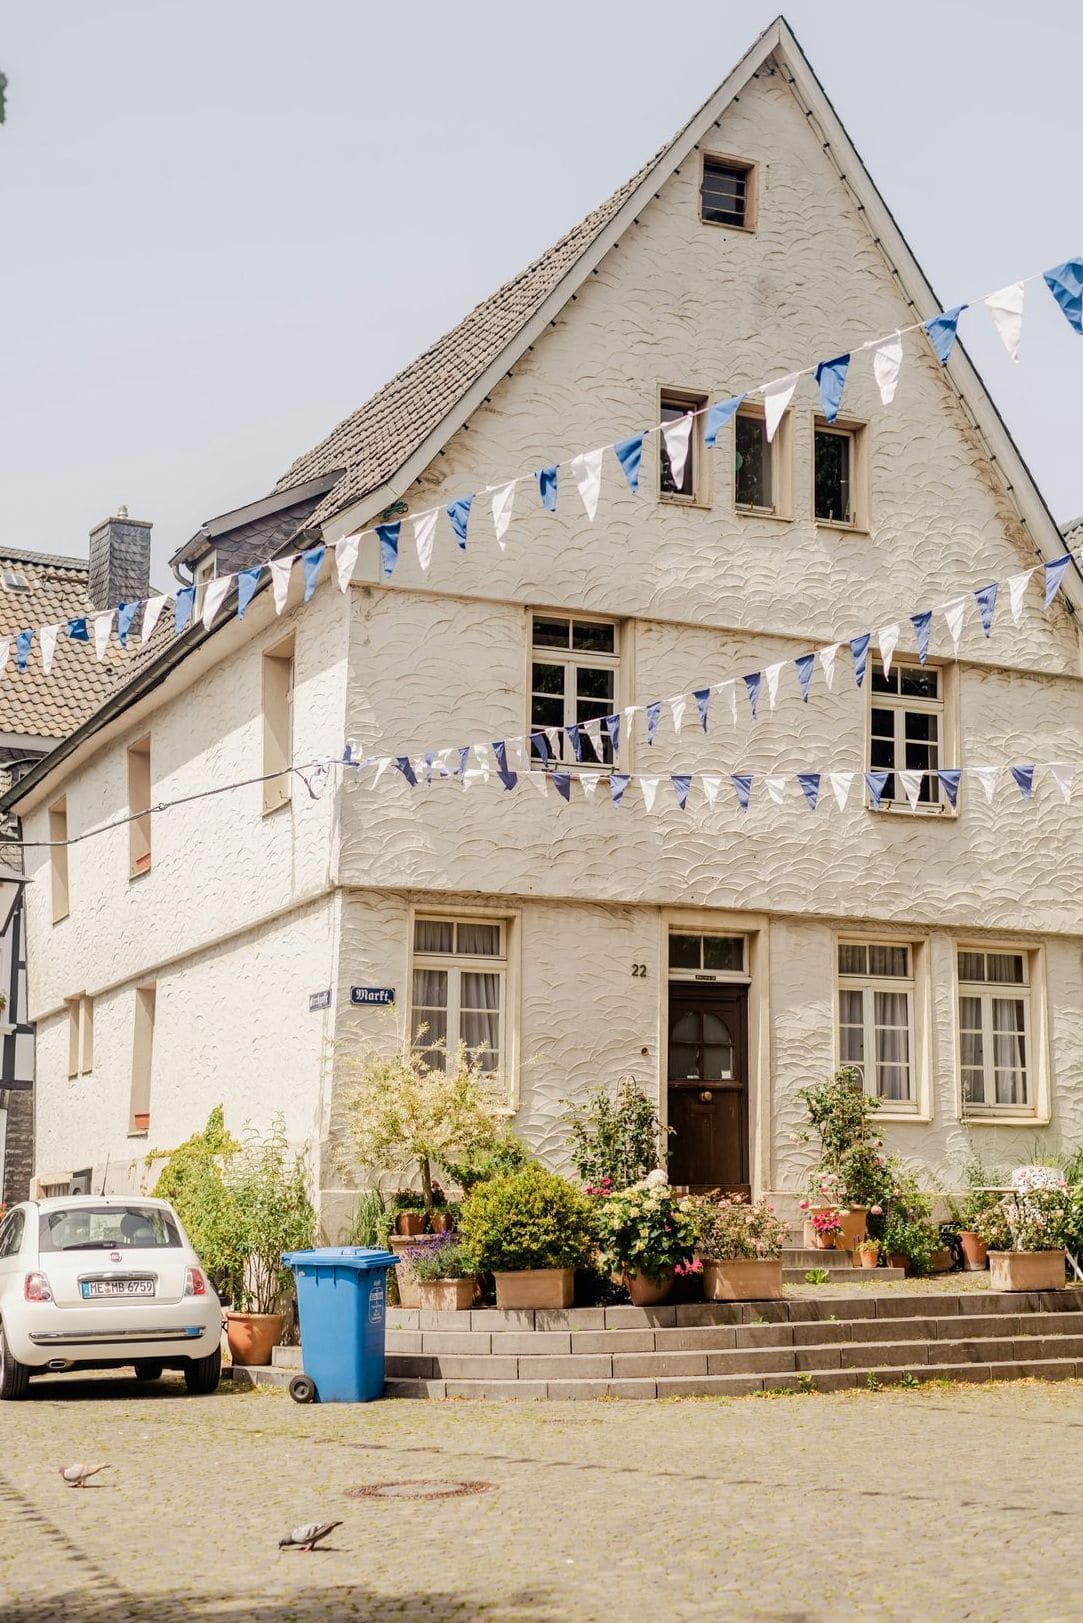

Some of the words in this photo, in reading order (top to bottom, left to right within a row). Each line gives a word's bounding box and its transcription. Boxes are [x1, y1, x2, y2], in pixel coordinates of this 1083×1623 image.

[631, 963, 647, 978] 22
[355, 989, 389, 1002] Markt
[127, 1281, 153, 1293] 6759
